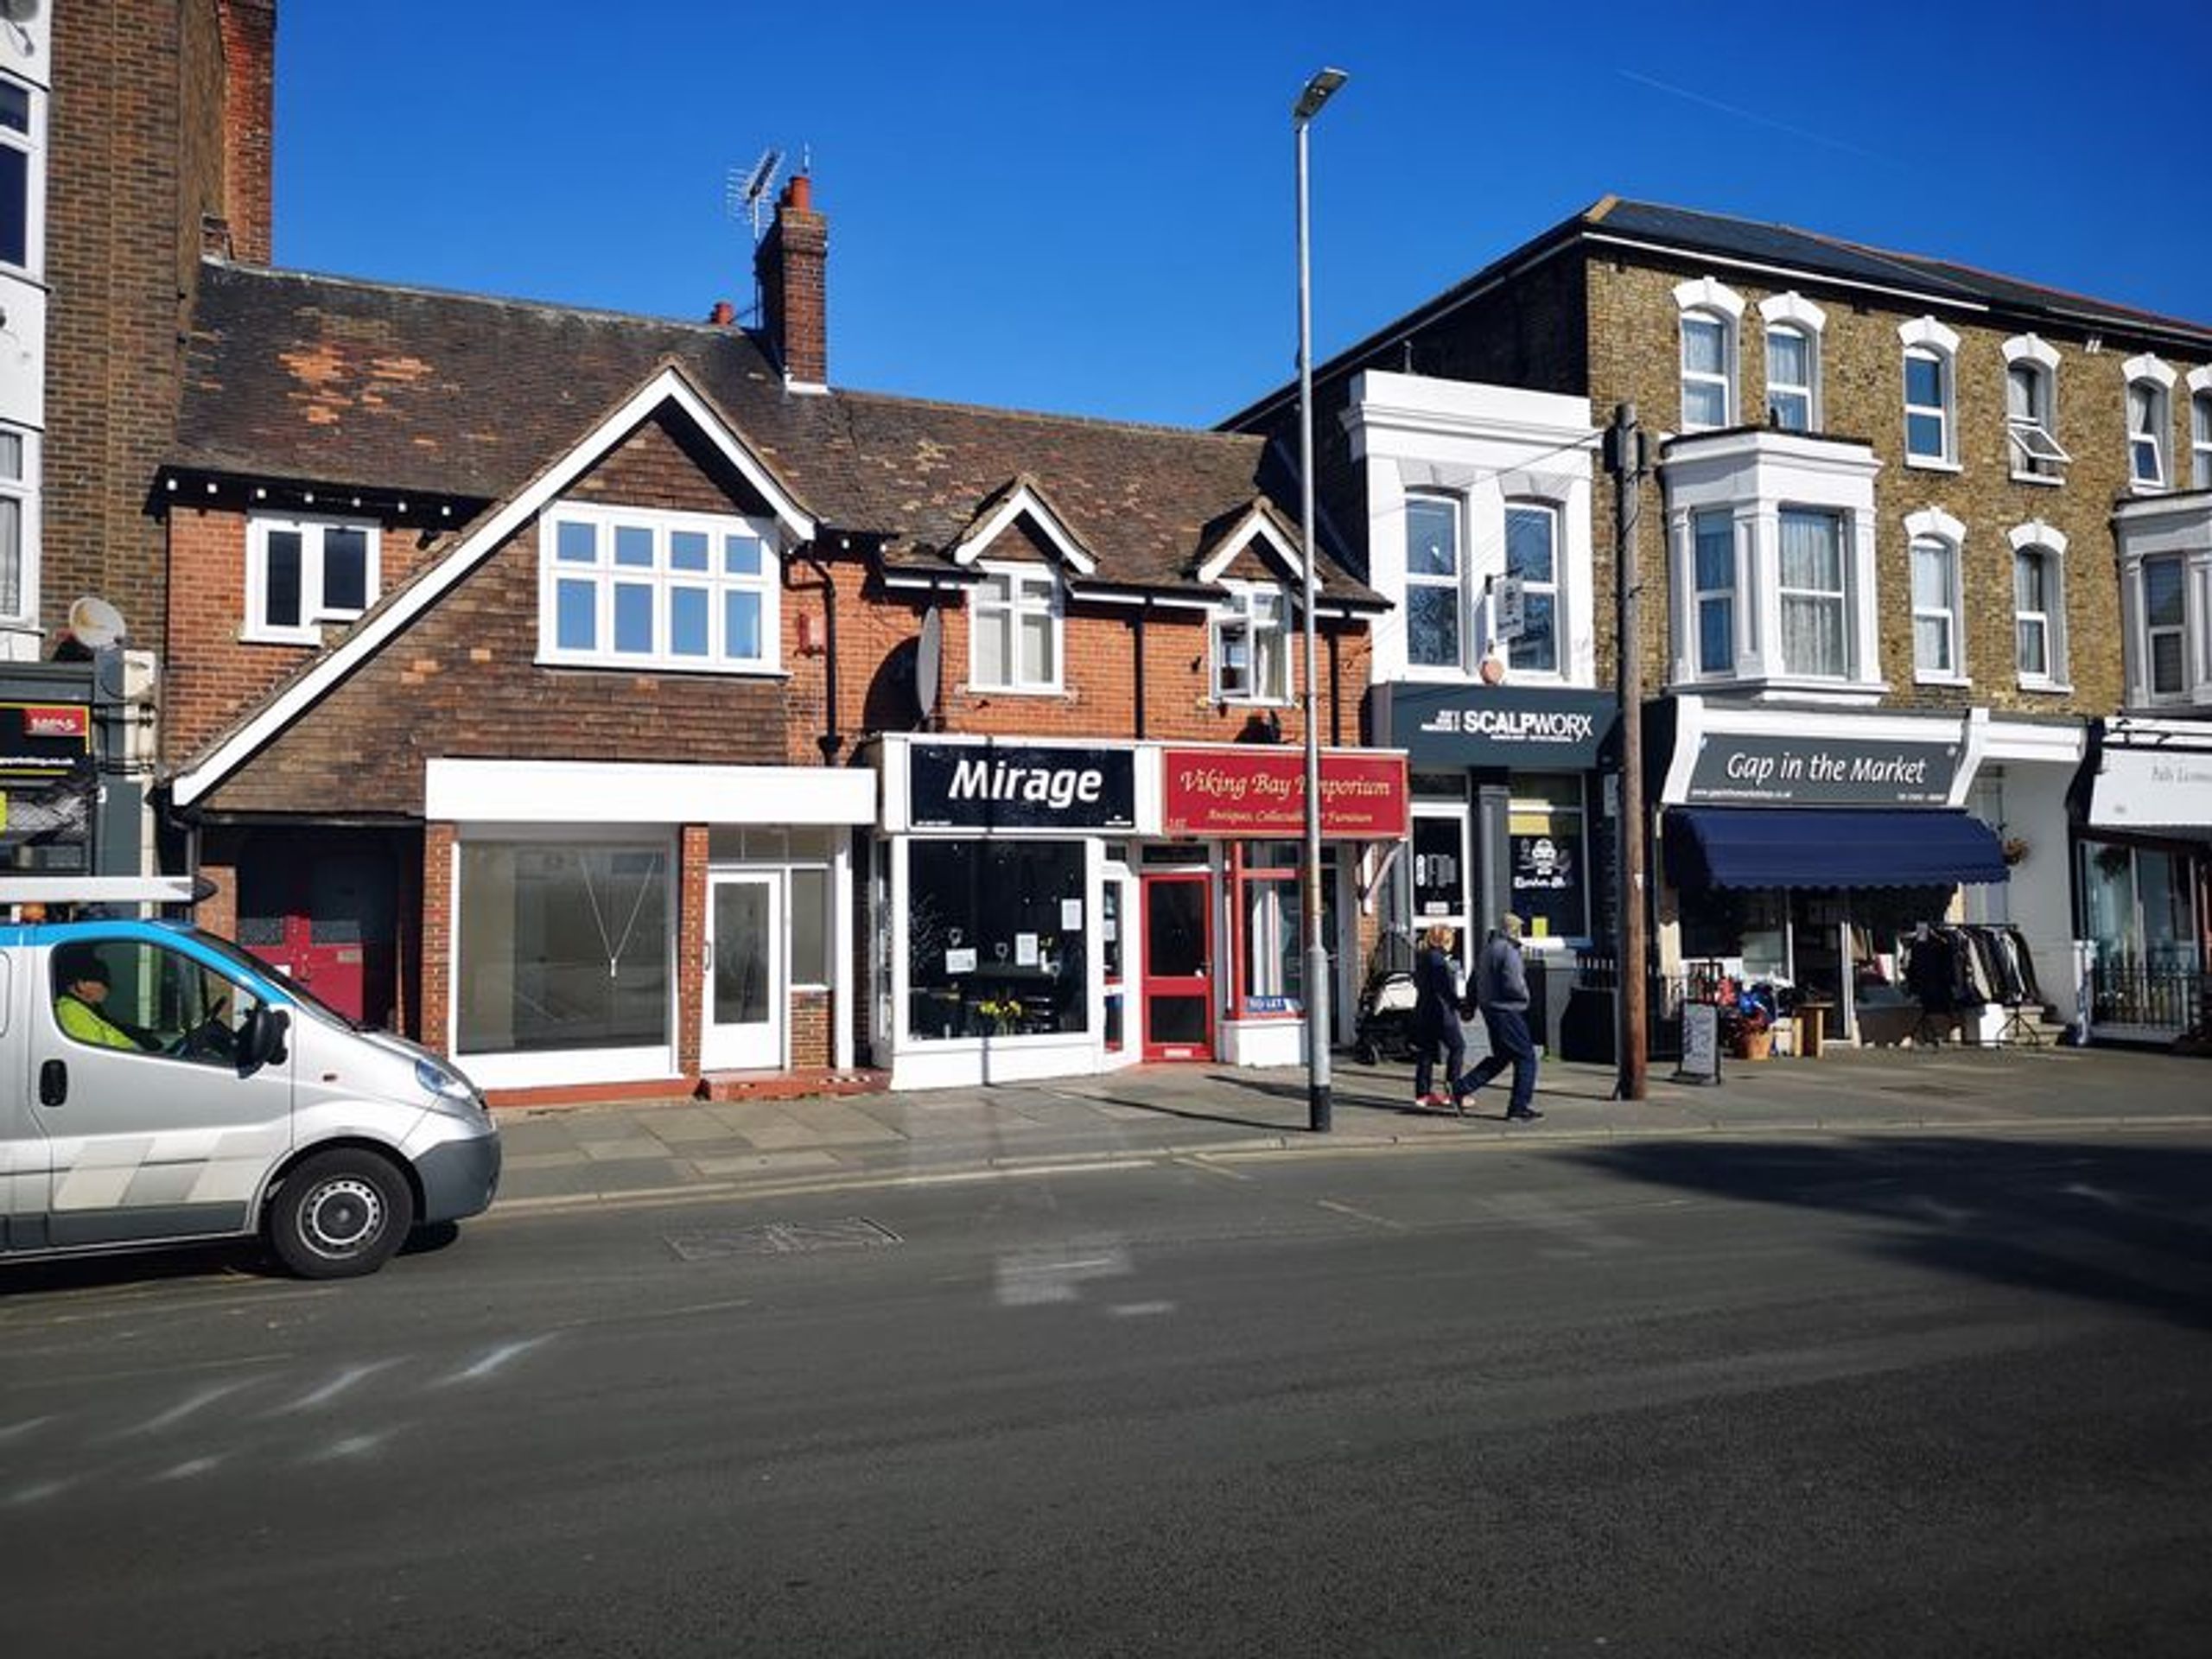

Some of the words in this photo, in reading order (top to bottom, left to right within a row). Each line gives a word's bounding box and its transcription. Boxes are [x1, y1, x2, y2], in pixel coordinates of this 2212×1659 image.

[1463, 709, 1592, 741] SCALPWORX
[948, 760, 1103, 809] Mirage
[1180, 768, 1248, 800] Viking
[1252, 772, 1293, 800] Bay
[1727, 752, 1773, 785] Gap
[1780, 752, 1803, 779] in
[1810, 753, 1847, 781] the
[1849, 754, 1927, 785] Market
